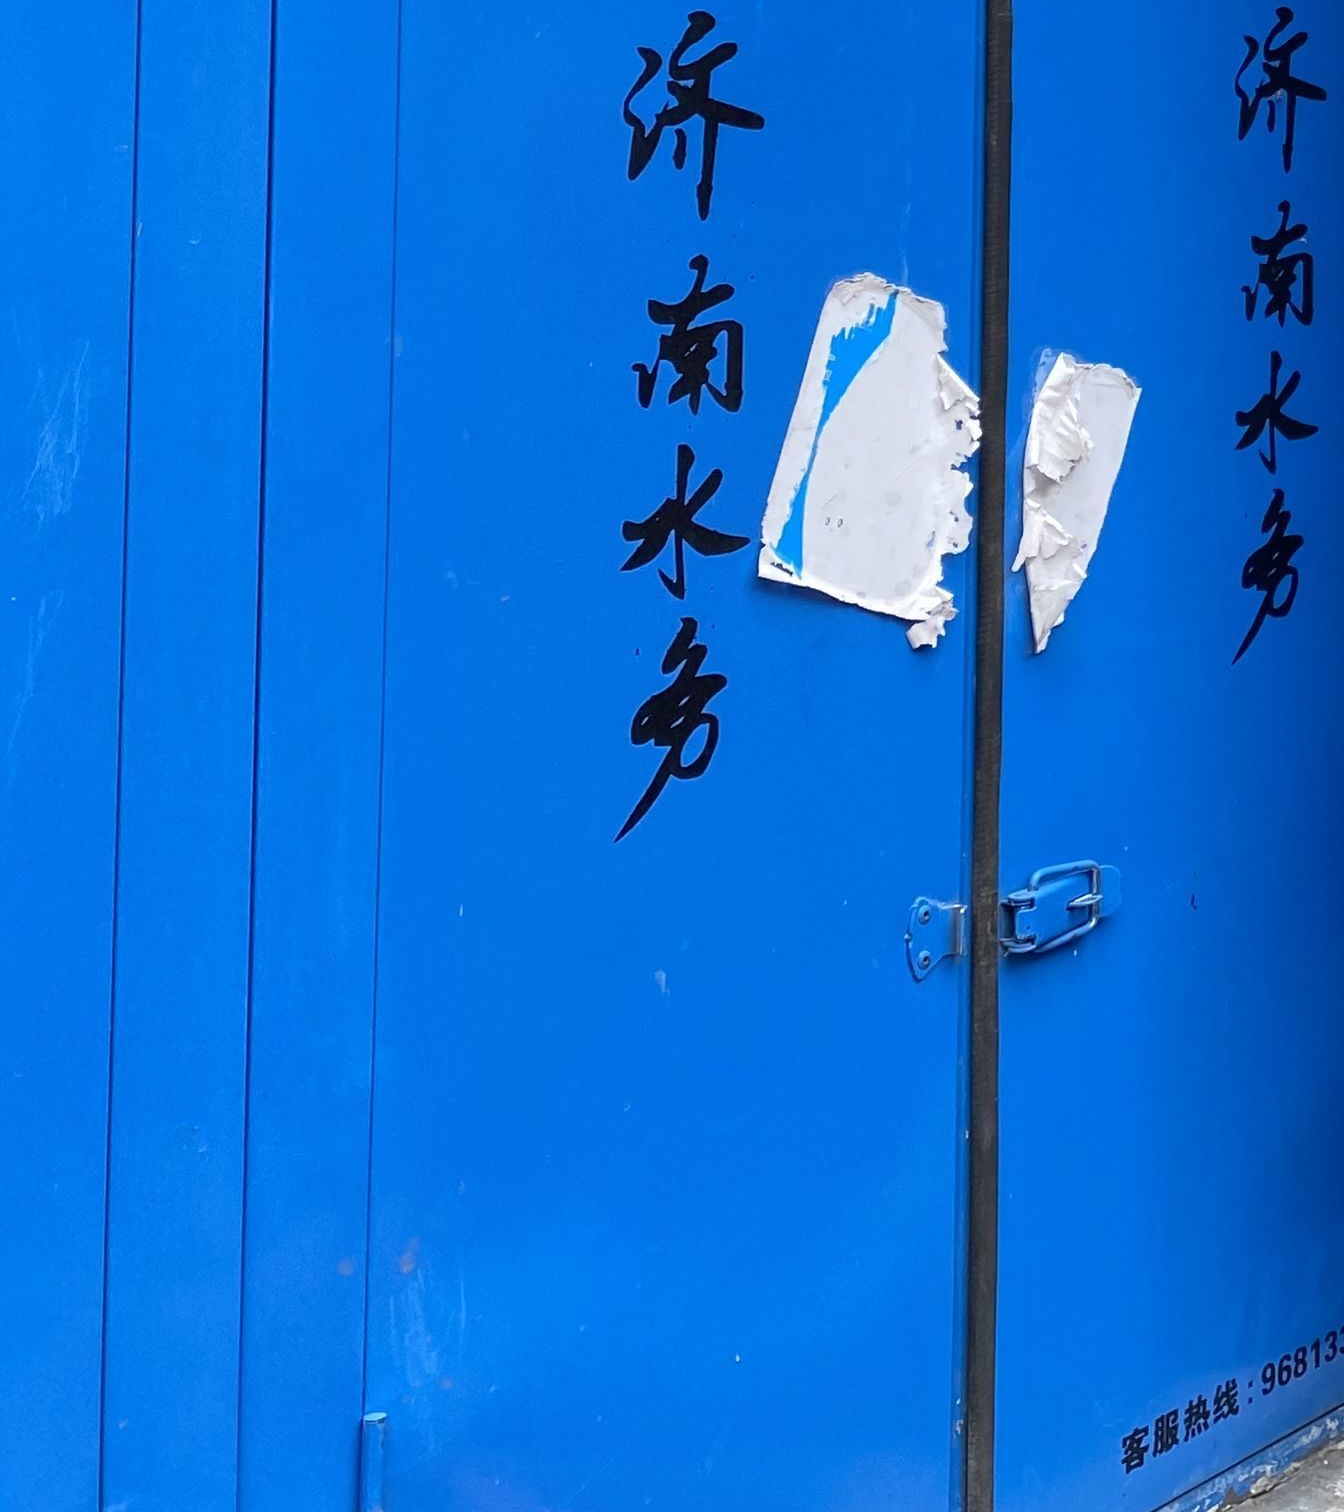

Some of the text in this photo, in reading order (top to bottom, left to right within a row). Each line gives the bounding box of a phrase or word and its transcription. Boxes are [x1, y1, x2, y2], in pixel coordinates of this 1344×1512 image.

[614, 10, 765, 845] 济南水务
[1233, 6, 1328, 666] 济南水务
